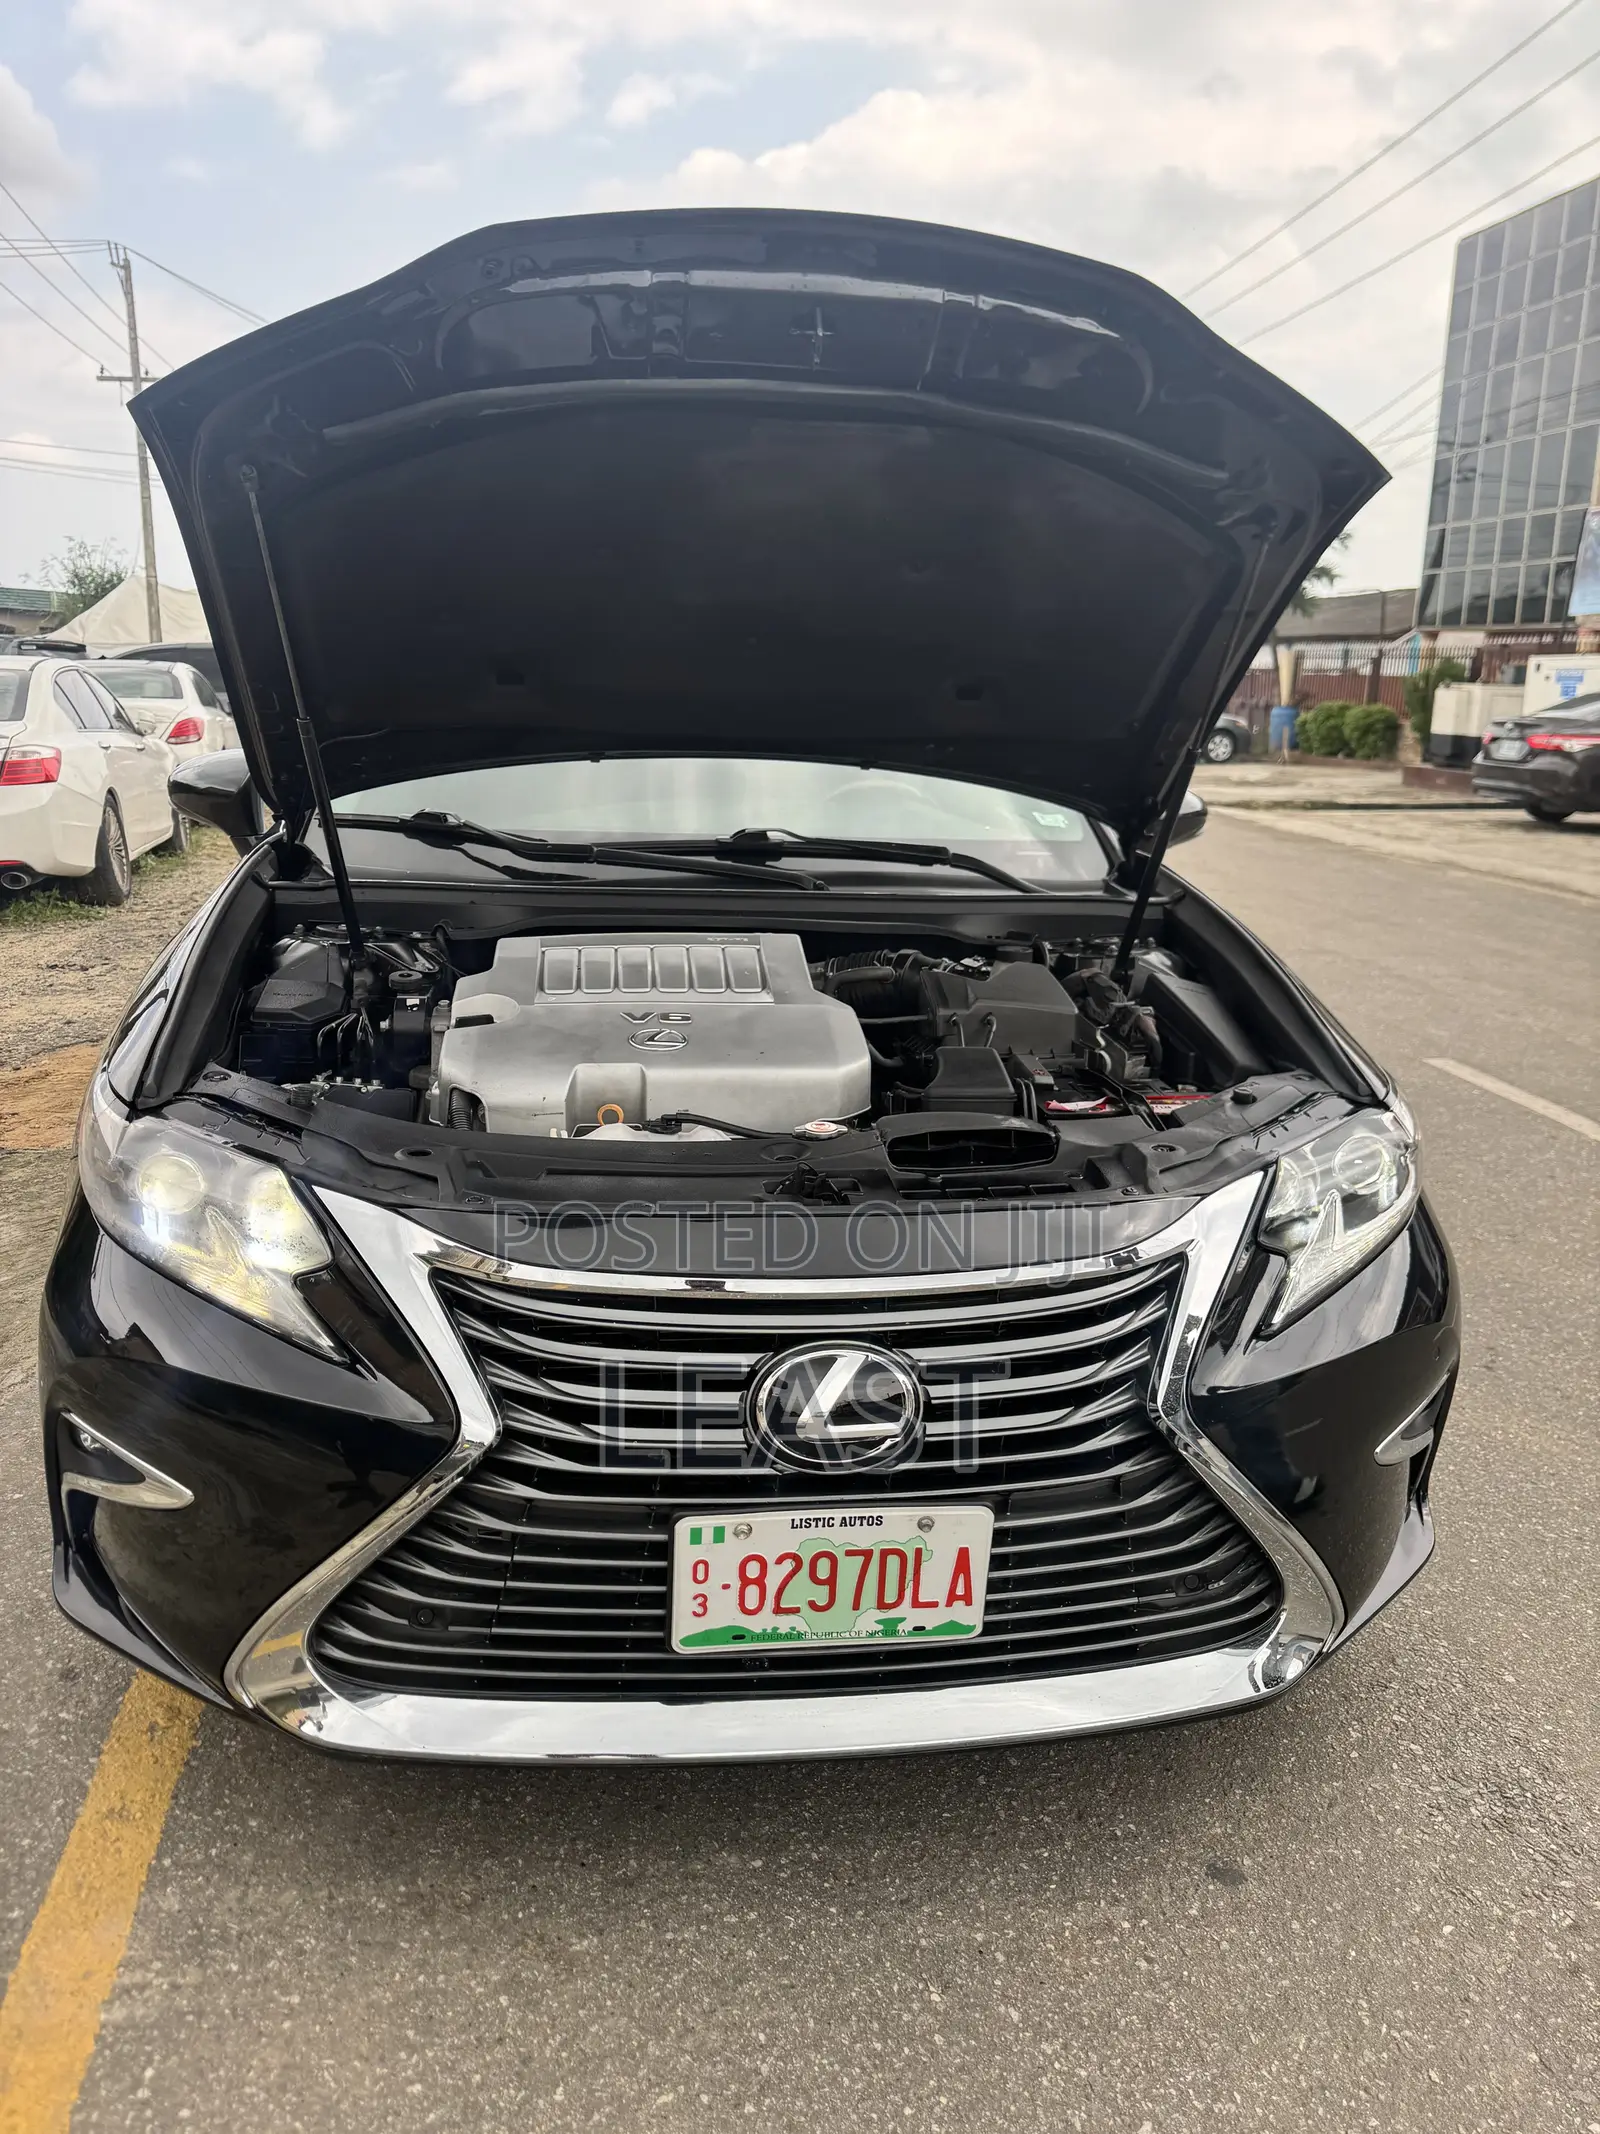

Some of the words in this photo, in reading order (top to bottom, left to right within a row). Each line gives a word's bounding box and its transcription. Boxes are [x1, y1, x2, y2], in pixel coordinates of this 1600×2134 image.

[619, 1011, 692, 1024] V6
[790, 1516, 836, 1530] LISTIC
[839, 1515, 884, 1528] AUTOS
[750, 1631, 797, 1642] FEDERAL
[798, 1629, 848, 1640] REPUBLIC
[849, 1629, 863, 1638] OF
[865, 1628, 908, 1638] NIGERIA
